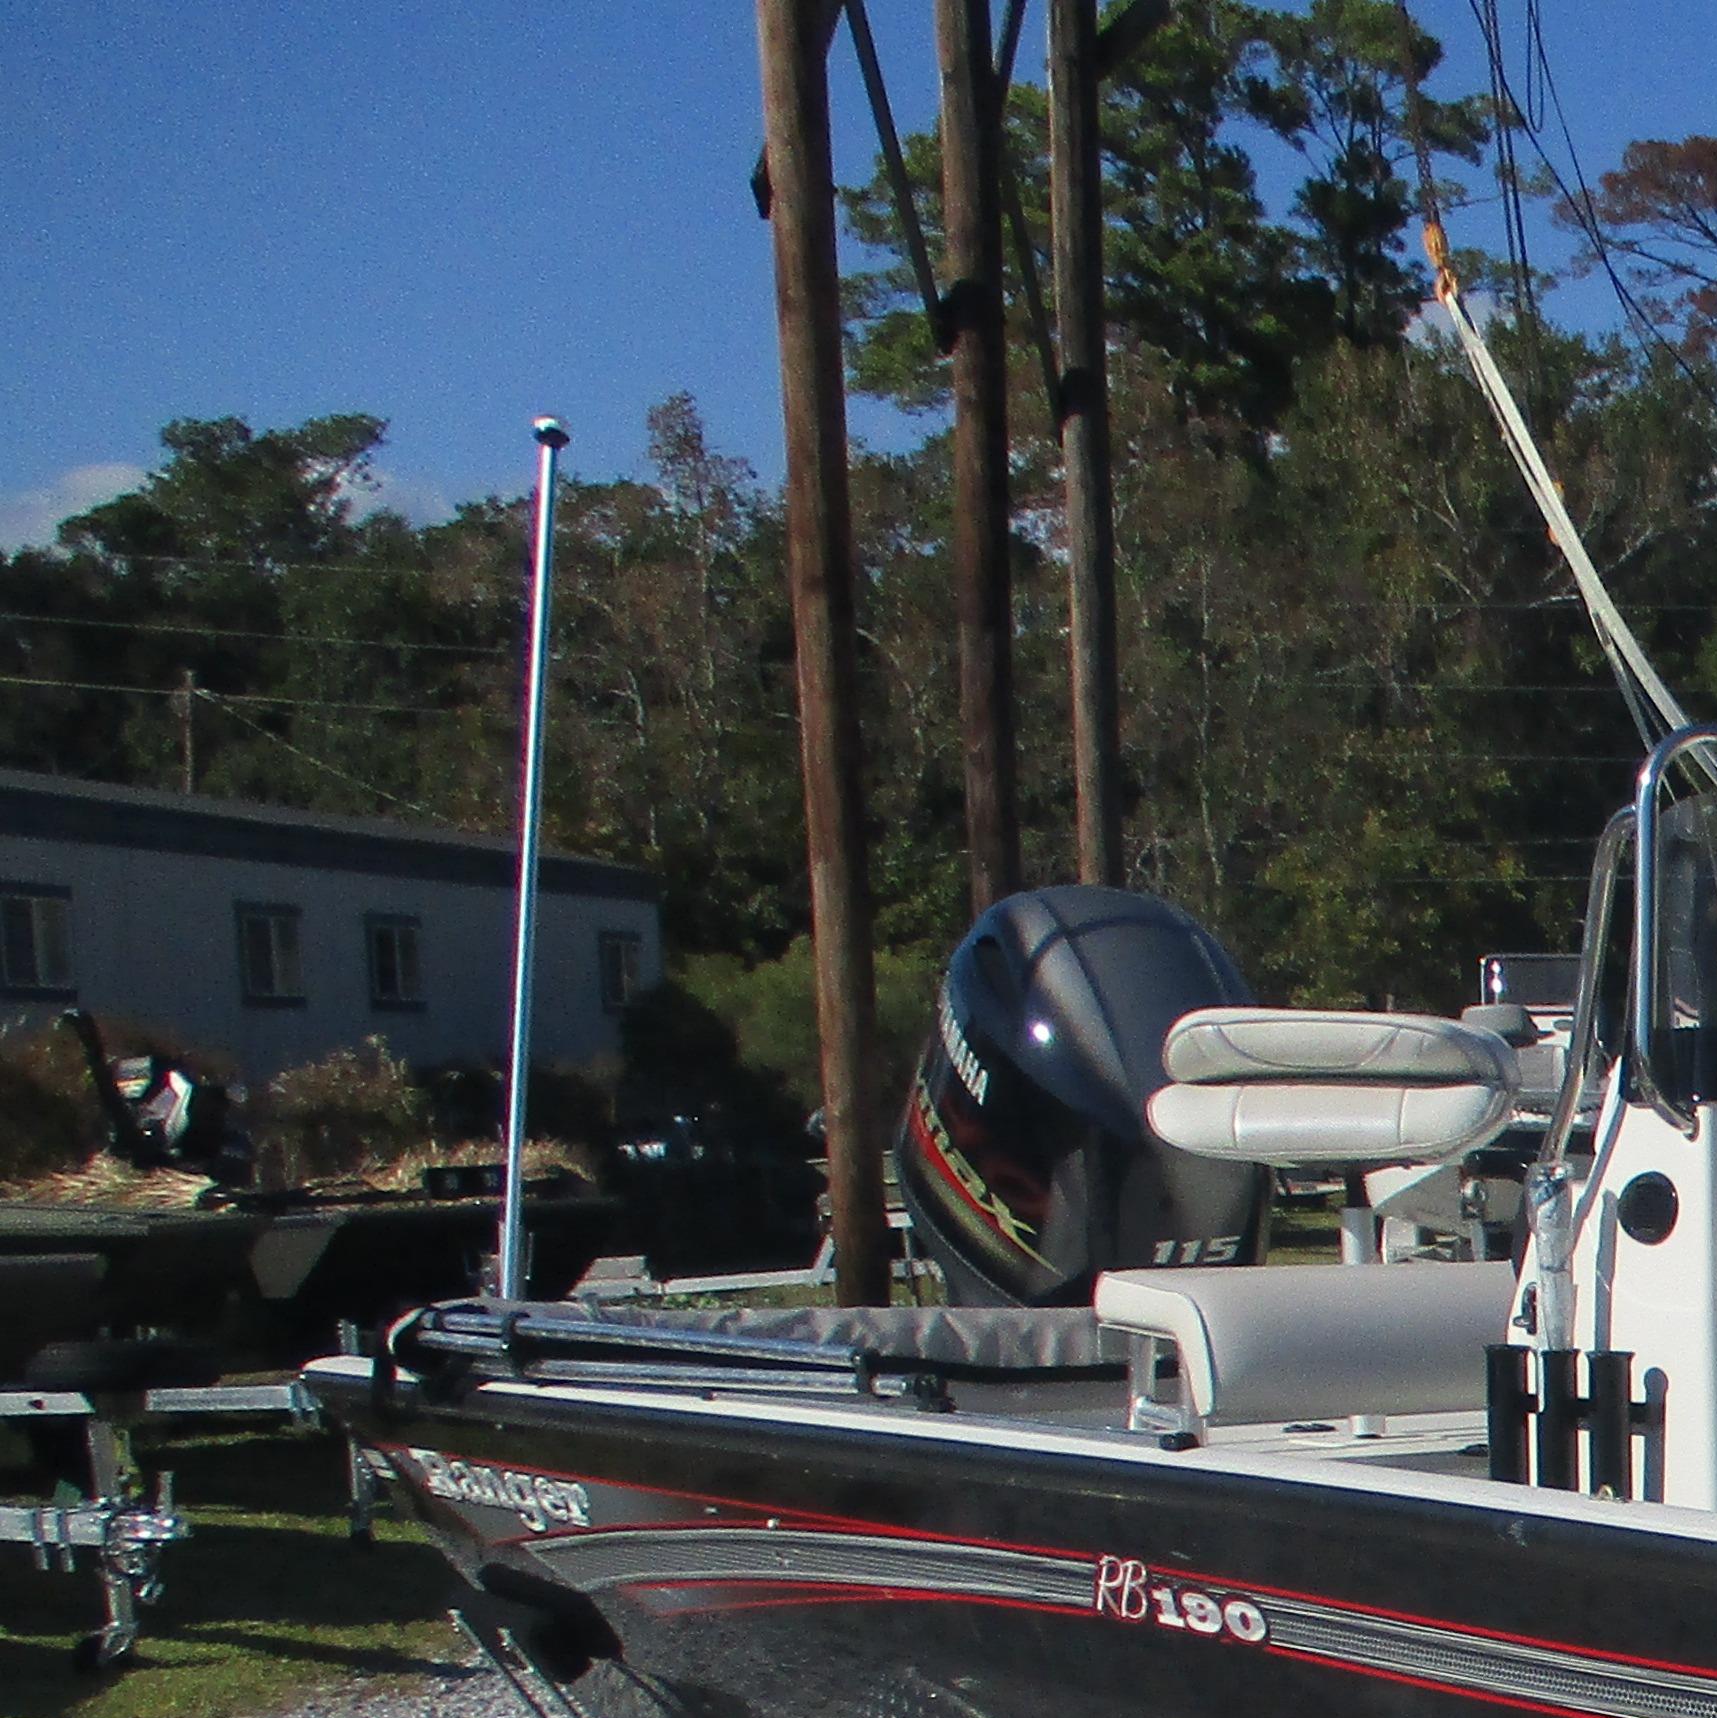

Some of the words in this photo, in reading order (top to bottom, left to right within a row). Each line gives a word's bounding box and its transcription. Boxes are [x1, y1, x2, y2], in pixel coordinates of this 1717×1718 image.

[1152, 1236, 1241, 1265] 115
[407, 1447, 592, 1533] Ranger
[1097, 1554, 1149, 1620] RB
[1151, 1586, 1267, 1643] 190
